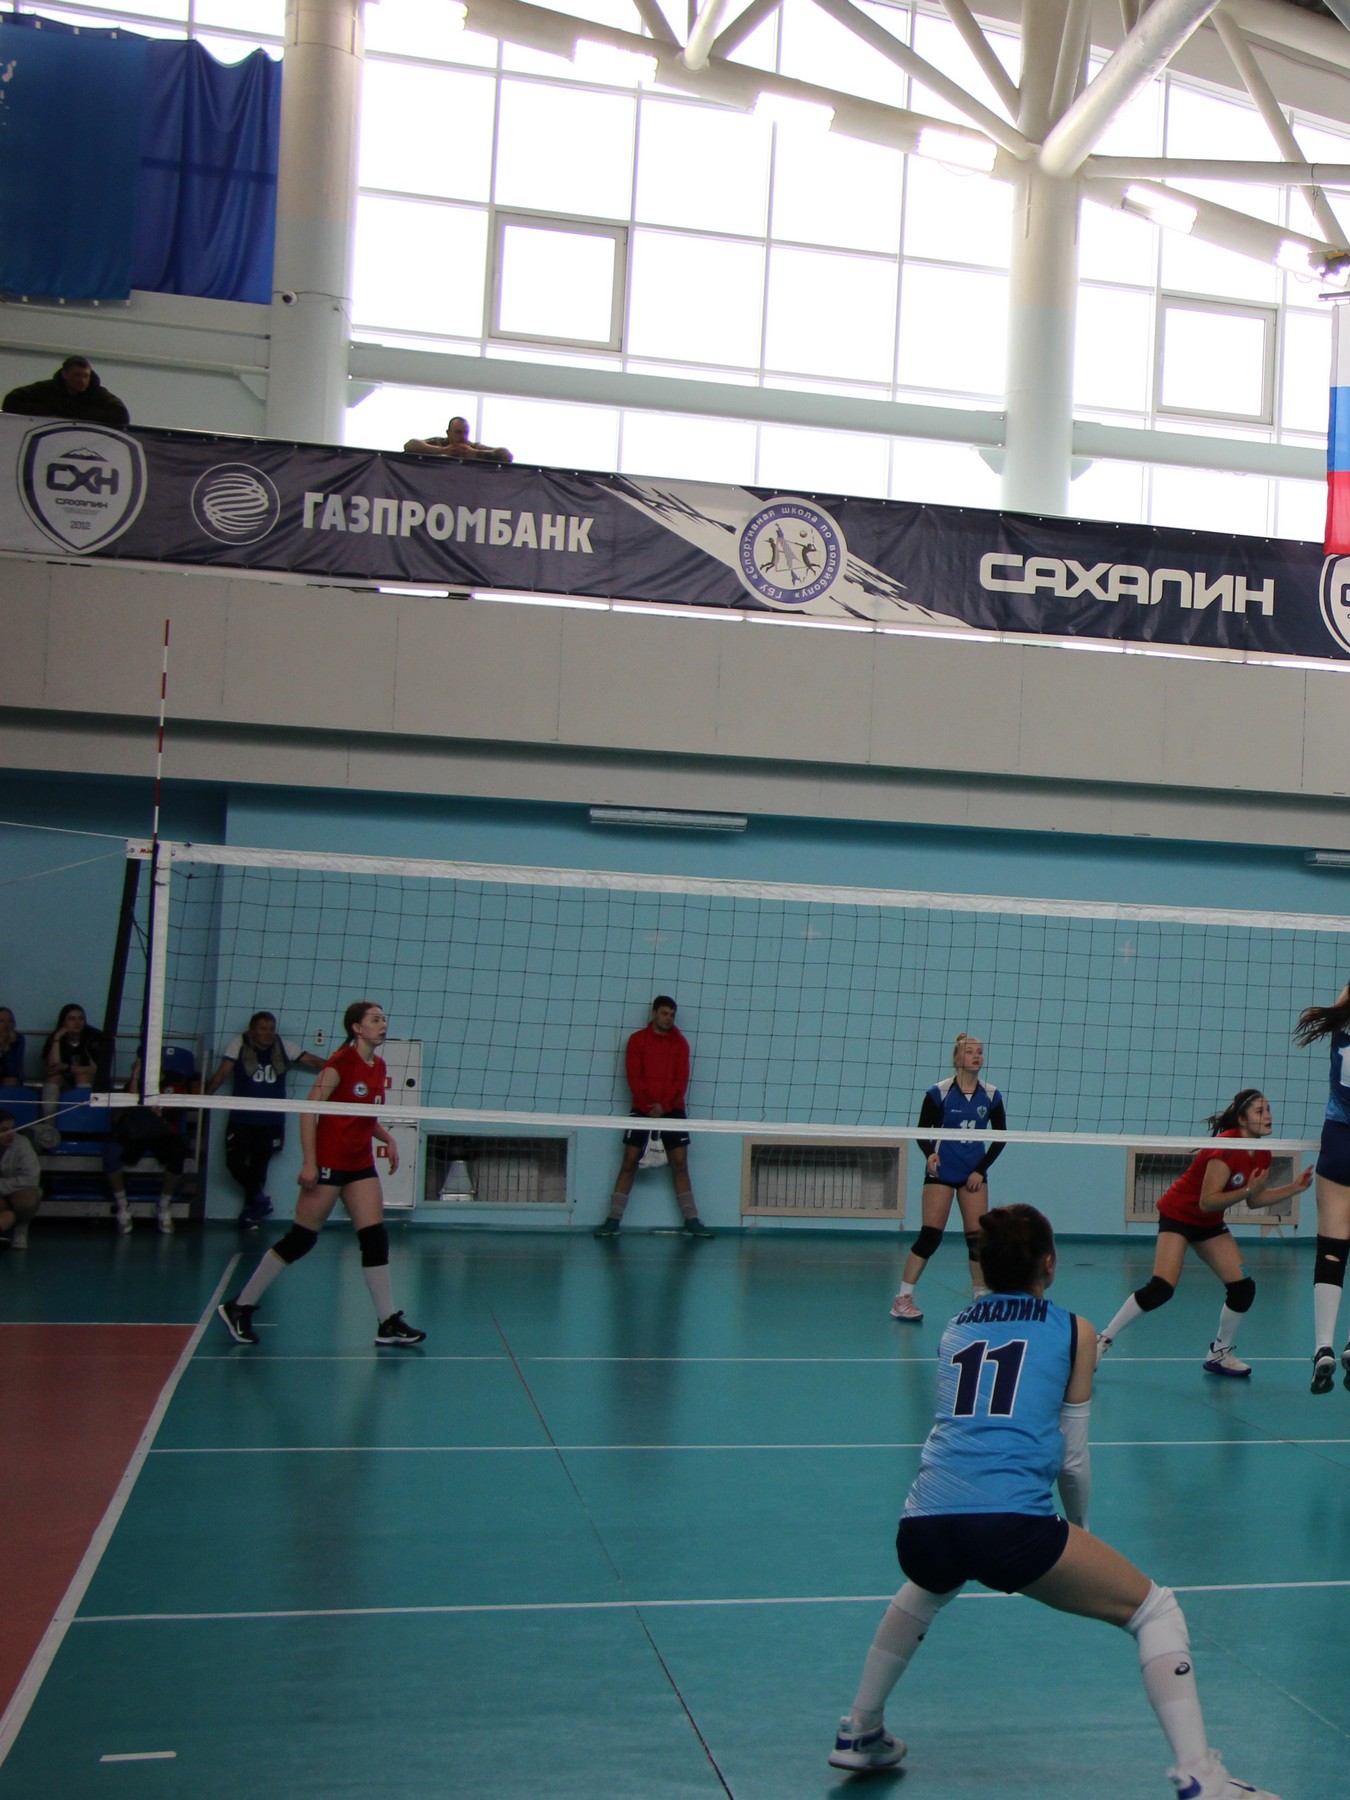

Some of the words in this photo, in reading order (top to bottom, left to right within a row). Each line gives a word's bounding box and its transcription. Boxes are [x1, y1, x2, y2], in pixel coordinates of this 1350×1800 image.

[70, 521, 91, 530] 2012
[302, 491, 595, 554] ГАЗПРОМБАНК
[760, 583, 783, 599] ГБУ
[820, 524, 832, 539] по
[979, 552, 1275, 616] САХАЛИН
[956, 1299, 1049, 1325] САХАЛИН
[951, 1339, 1029, 1418] 11
